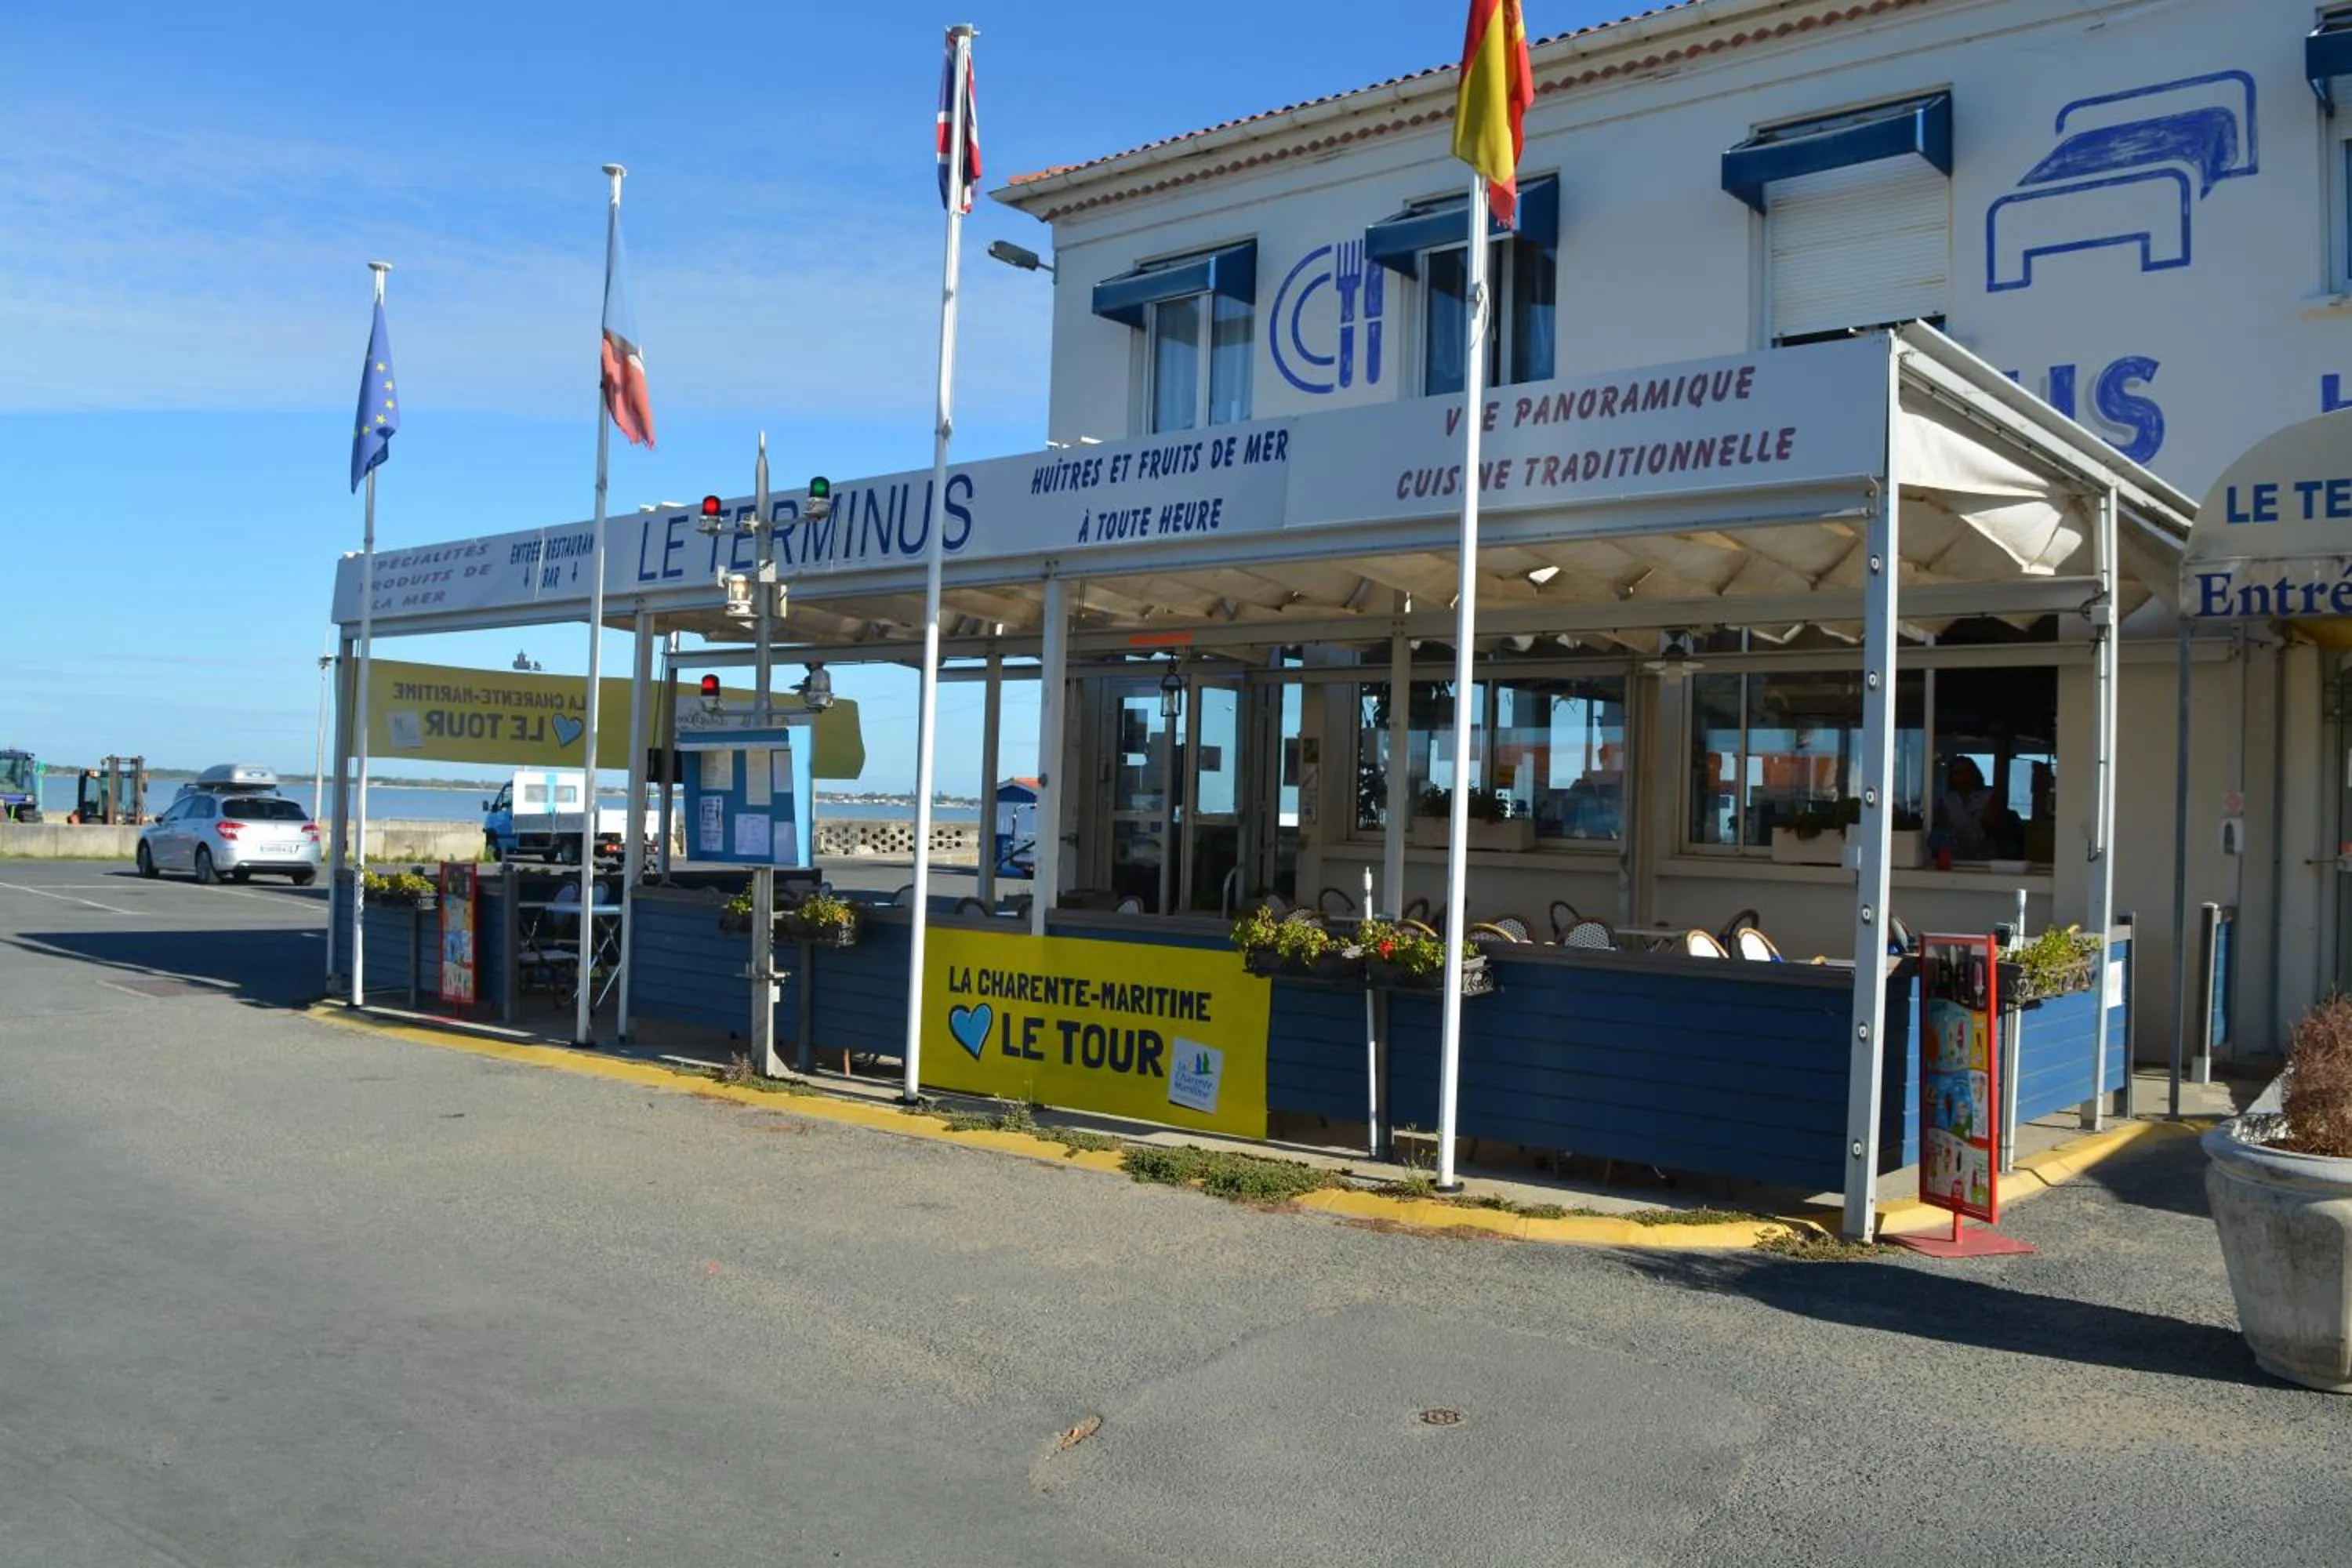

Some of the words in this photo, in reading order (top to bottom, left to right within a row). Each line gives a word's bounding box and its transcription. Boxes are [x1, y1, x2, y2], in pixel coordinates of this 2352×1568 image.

[1446, 401, 1500, 437] VE
[1513, 365, 1756, 428] PANORAMIQUE
[1030, 457, 1103, 495] HUÎTRES
[1109, 453, 1132, 485] ET
[1137, 441, 1203, 481] FRUITS
[1210, 436, 1237, 470] DE
[1243, 429, 1289, 464] MER
[1396, 459, 1512, 501] CUISNE
[1524, 426, 1797, 488] TRADITIONNELLE
[637, 514, 689, 582] LE
[704, 473, 975, 574] TERMINUS
[1077, 508, 1090, 543] À
[1096, 506, 1152, 542] TOUTE
[1158, 498, 1224, 535] HEURE
[2227, 482, 2278, 524] LE
[2294, 477, 2352, 521] TE
[463, 563, 494, 578] DE
[546, 532, 595, 561] RESTAURAN
[371, 597, 392, 611] LA
[401, 590, 446, 608] MER
[542, 565, 561, 590] BAR
[2194, 564, 2352, 618] Entré
[949, 965, 972, 994] LA
[978, 968, 1213, 1022] CHARENTE-MARITIME
[1002, 1012, 1045, 1061] LE
[1057, 1021, 1165, 1078] TOUR
